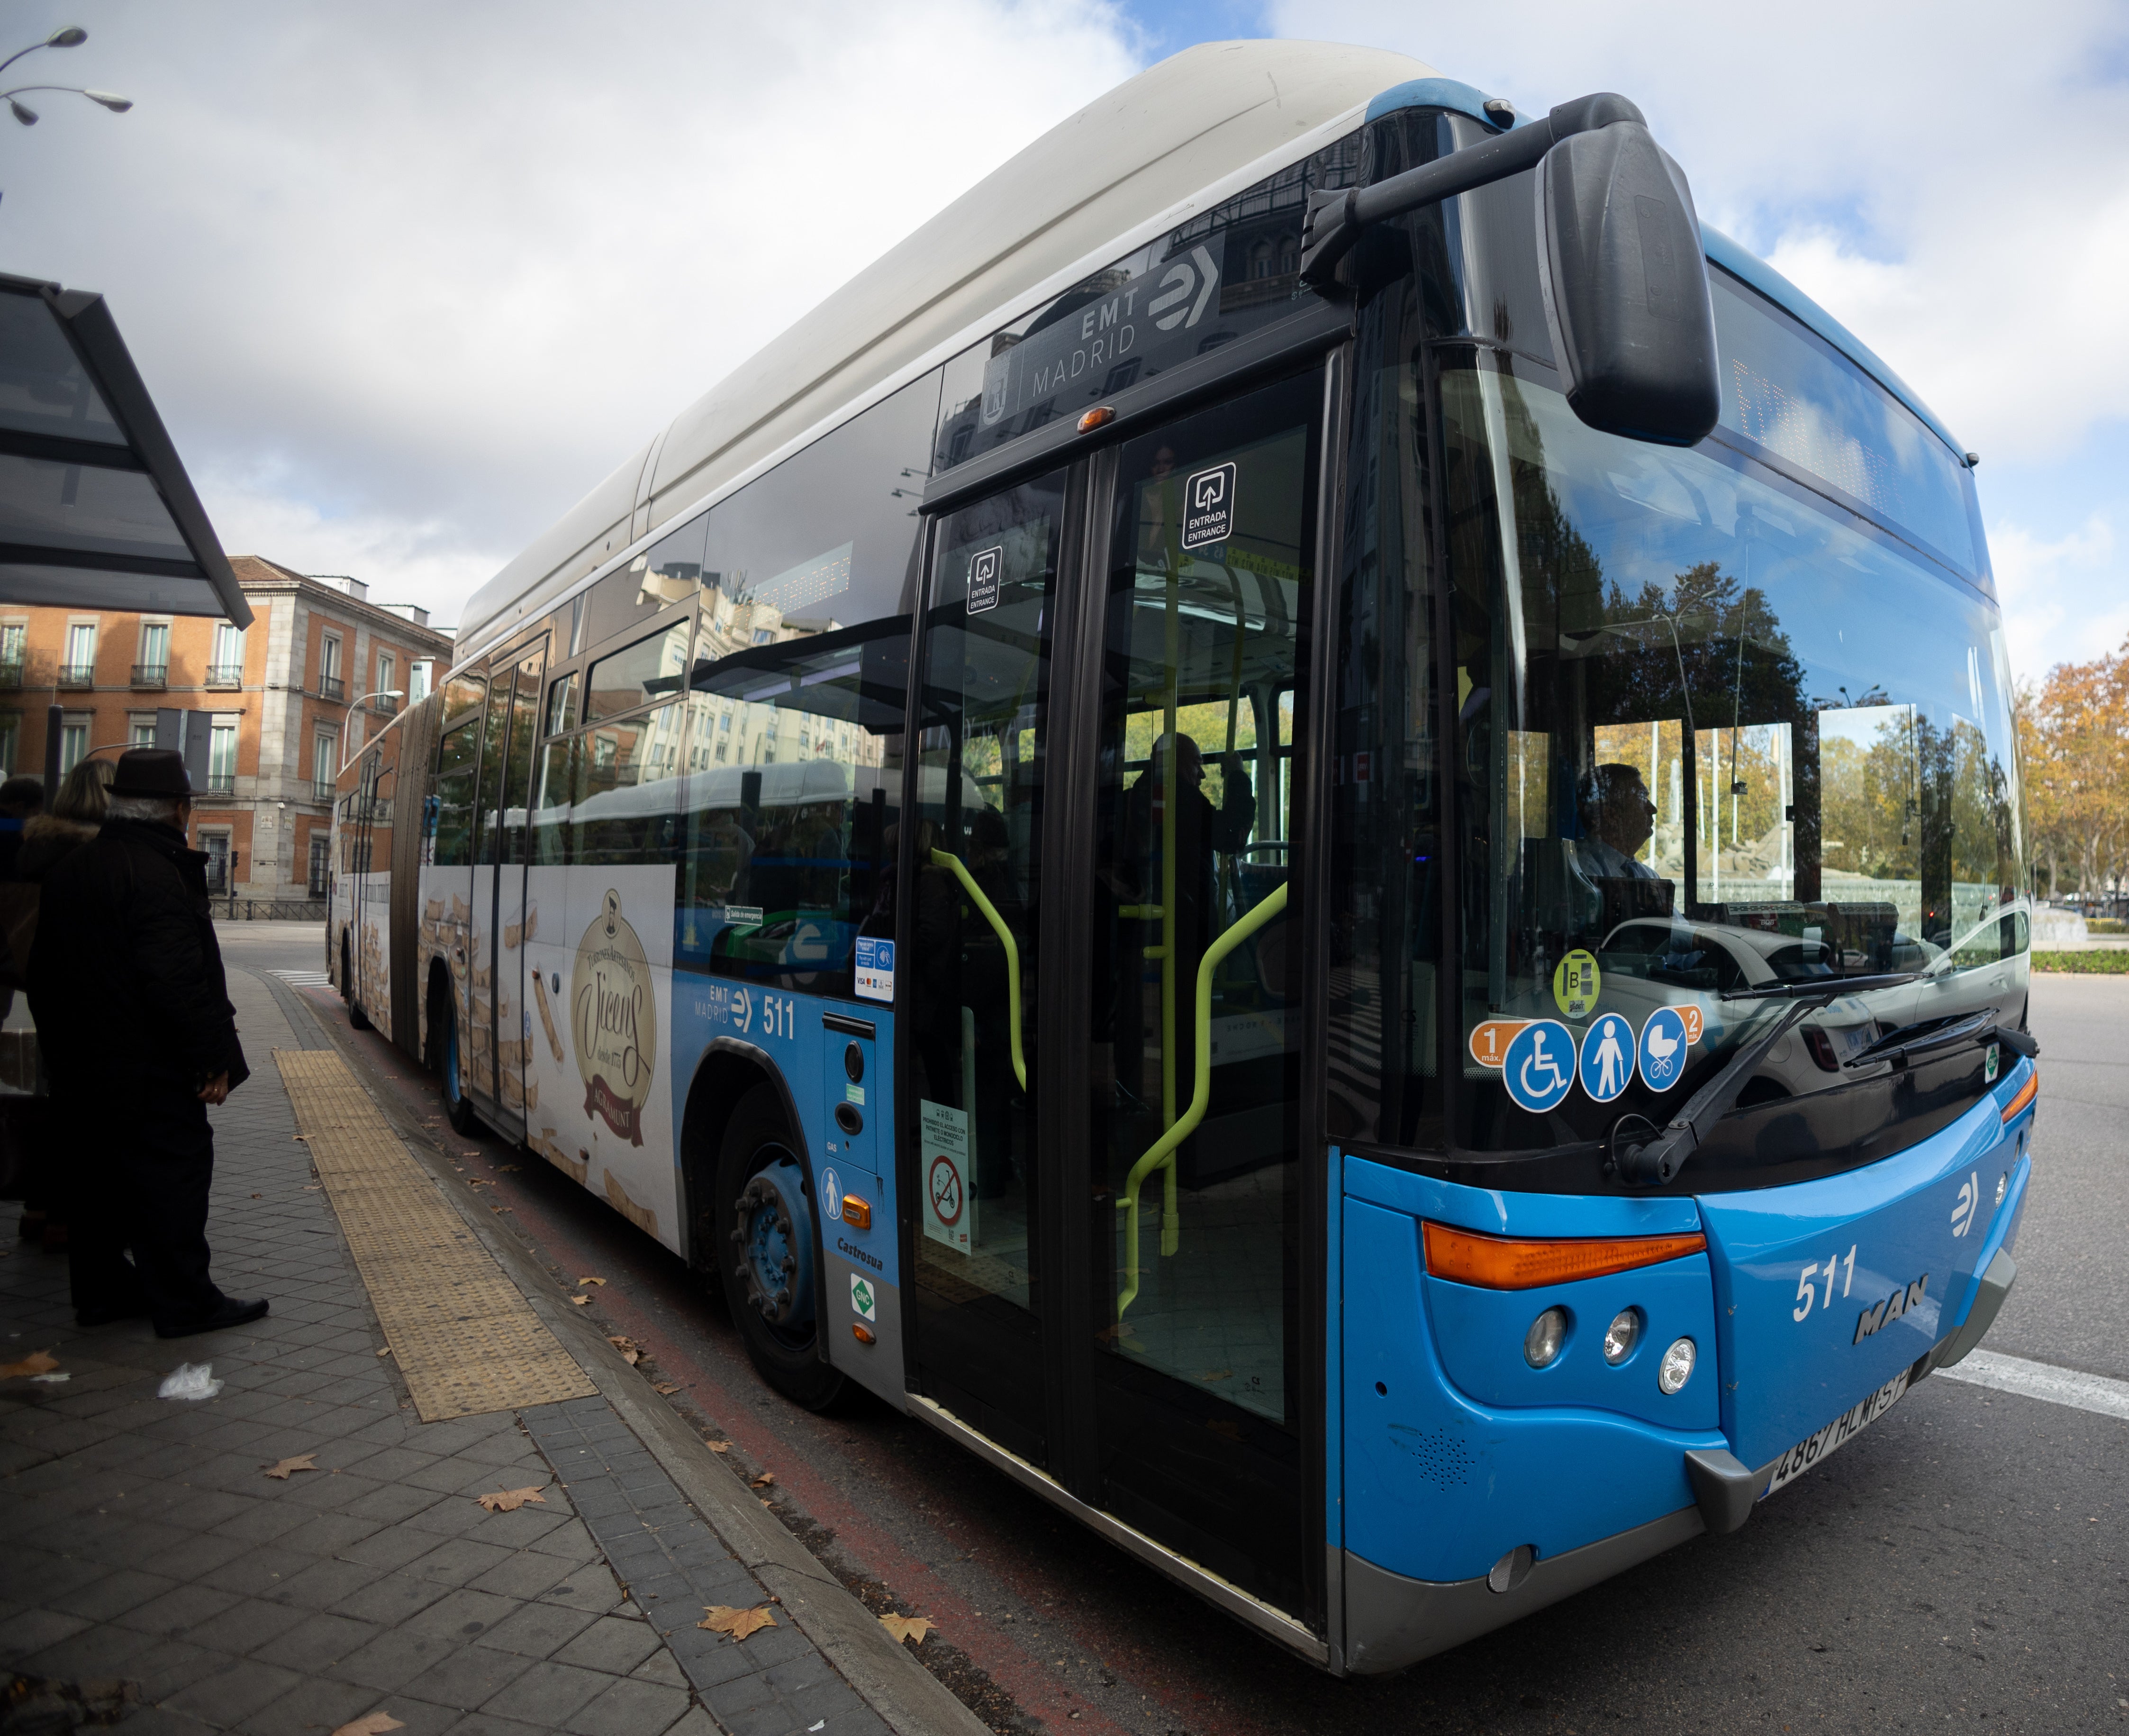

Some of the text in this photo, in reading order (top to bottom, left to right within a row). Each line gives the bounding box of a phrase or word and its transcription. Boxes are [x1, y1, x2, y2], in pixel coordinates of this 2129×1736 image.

[1081, 287, 1139, 341] EMT
[1033, 324, 1134, 398] MADRID
[1189, 510, 1226, 530] ENTRADA
[1188, 524, 1226, 542] ENTRANCE
[971, 585, 996, 598] ENTRADA
[970, 596, 995, 609] ENTRANCE
[744, 912, 761, 920] emergencia
[857, 977, 865, 985] VISA
[1569, 972, 1579, 988] B
[710, 985, 728, 1002] EMT
[695, 1000, 728, 1024] MADRID
[764, 996, 794, 1039] 511
[1689, 1011, 1698, 1032] 2
[576, 971, 652, 1087] Vicens
[1484, 1028, 1496, 1054] 1
[597, 1045, 621, 1069] desde 1775
[1481, 1054, 1501, 1062] máx.
[1988, 1056, 1996, 1069] GNC
[594, 1087, 630, 1128] AGRAMUNT
[923, 1117, 940, 1127] PROHIBIDO
[944, 1123, 958, 1133] ACCESO
[926, 1125, 940, 1135] PATINETE
[943, 1130, 963, 1141] MONOCICLO
[827, 1142, 837, 1153] GAS
[933, 1135, 954, 1146] ELÉCTRICOS
[837, 1236, 883, 1272] Castrosua
[1794, 1245, 1857, 1322] 511
[856, 1288, 870, 1305] GNC
[1854, 1273, 1929, 1345] MAN
[1776, 1422, 1835, 1482] 4867
